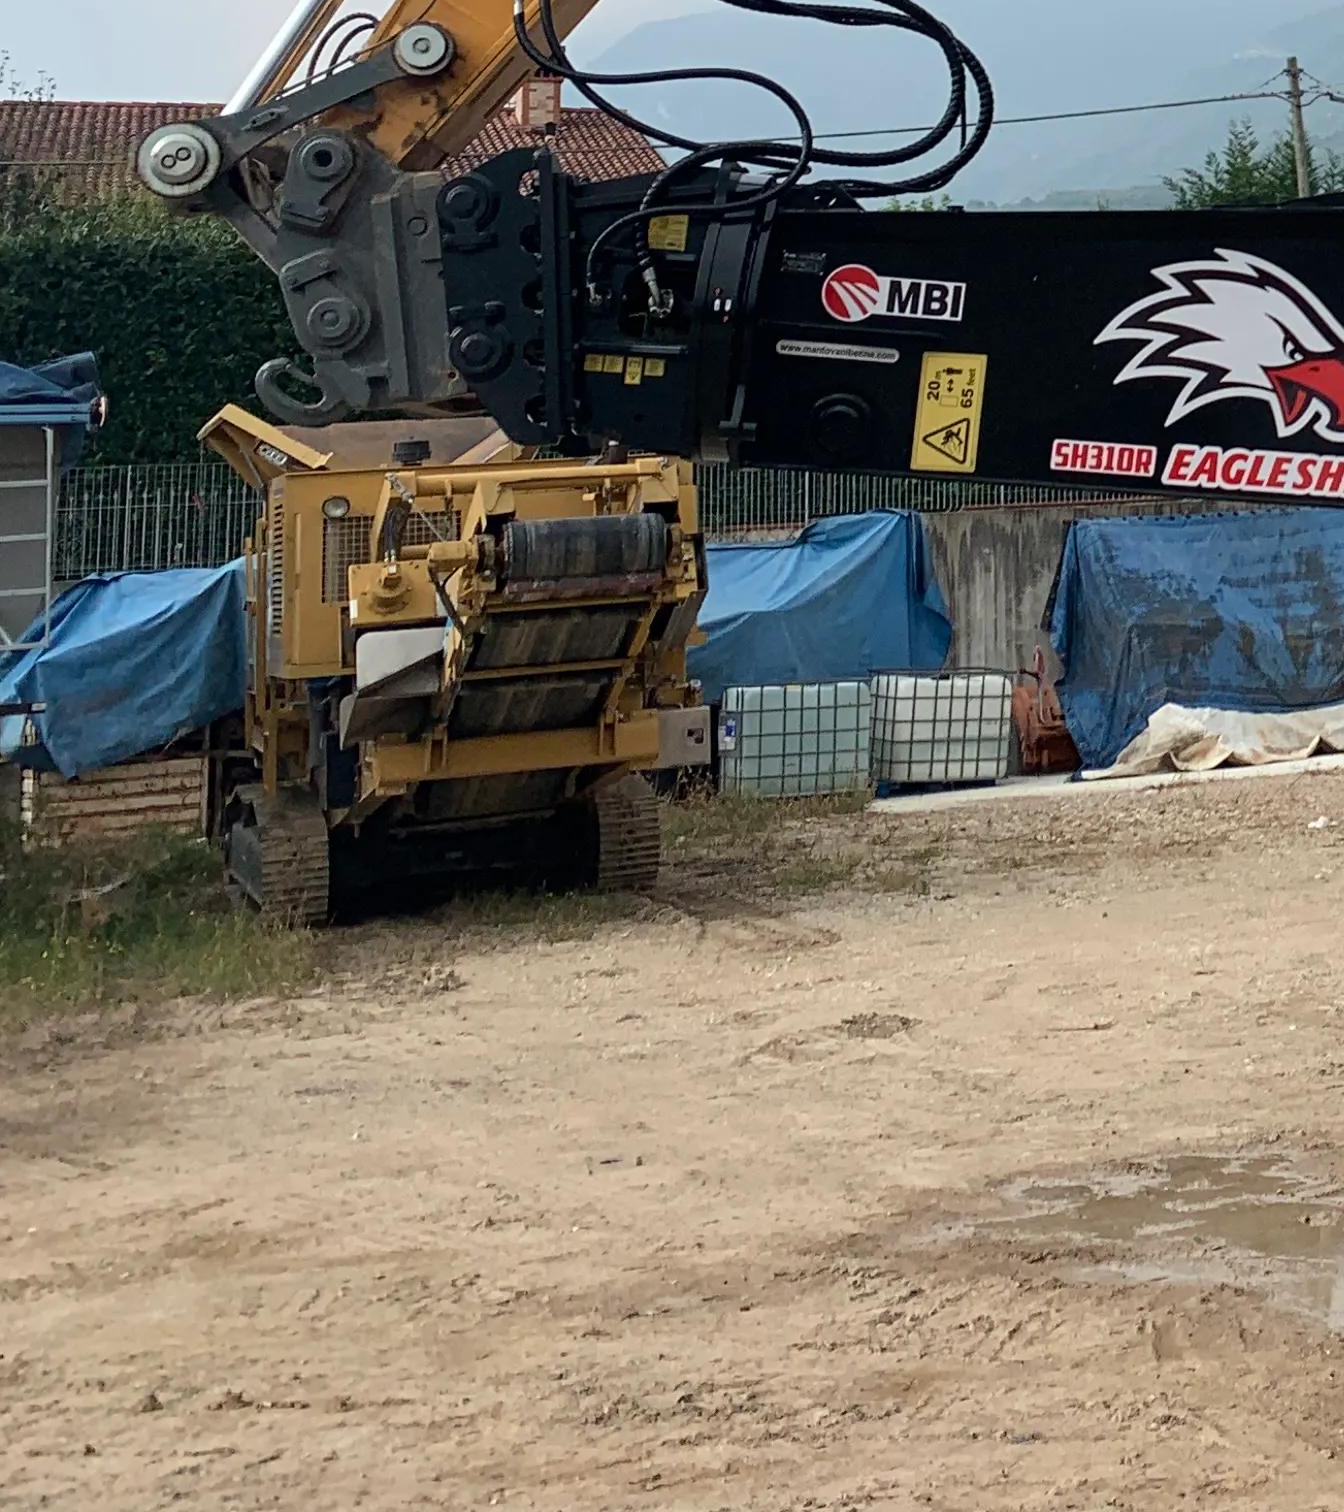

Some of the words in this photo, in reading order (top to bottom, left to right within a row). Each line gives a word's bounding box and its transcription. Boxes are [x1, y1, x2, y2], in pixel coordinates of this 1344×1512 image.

[886, 281, 963, 318] MBI
[926, 380, 941, 402] 20
[960, 388, 974, 409] 65
[1054, 441, 1154, 474] SH310R
